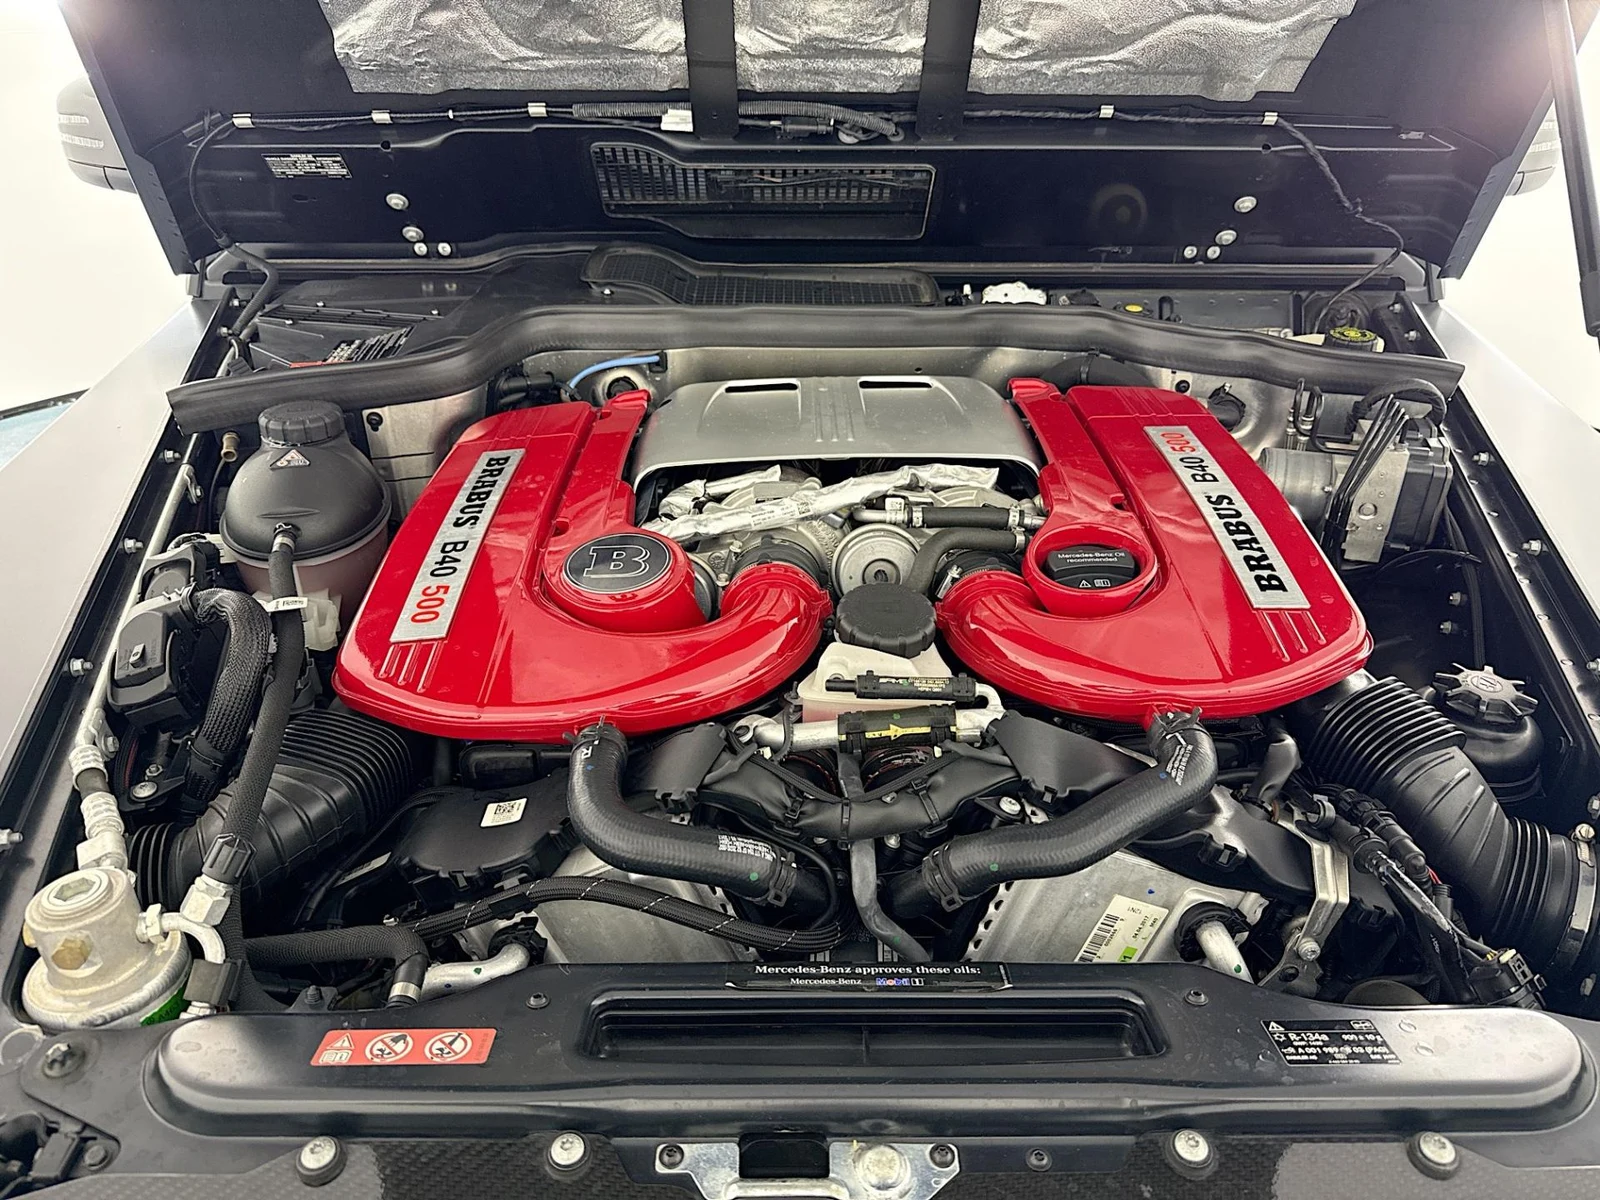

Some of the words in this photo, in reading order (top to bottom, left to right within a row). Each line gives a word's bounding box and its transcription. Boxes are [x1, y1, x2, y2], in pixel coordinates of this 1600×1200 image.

[1161, 432, 1196, 453] 500
[1179, 456, 1219, 482] B40
[453, 456, 511, 528] BRABUS
[1205, 494, 1288, 592] BRABUS
[430, 540, 469, 577] B40
[583, 544, 651, 579] B
[411, 584, 450, 623] 500
[755, 965, 852, 974] Mercedes-Benz
[855, 966, 912, 975] approves
[916, 965, 951, 974] these
[954, 965, 981, 974] oils:
[876, 977, 910, 986] Mobil
[1288, 1032, 1330, 1041] R-134a
